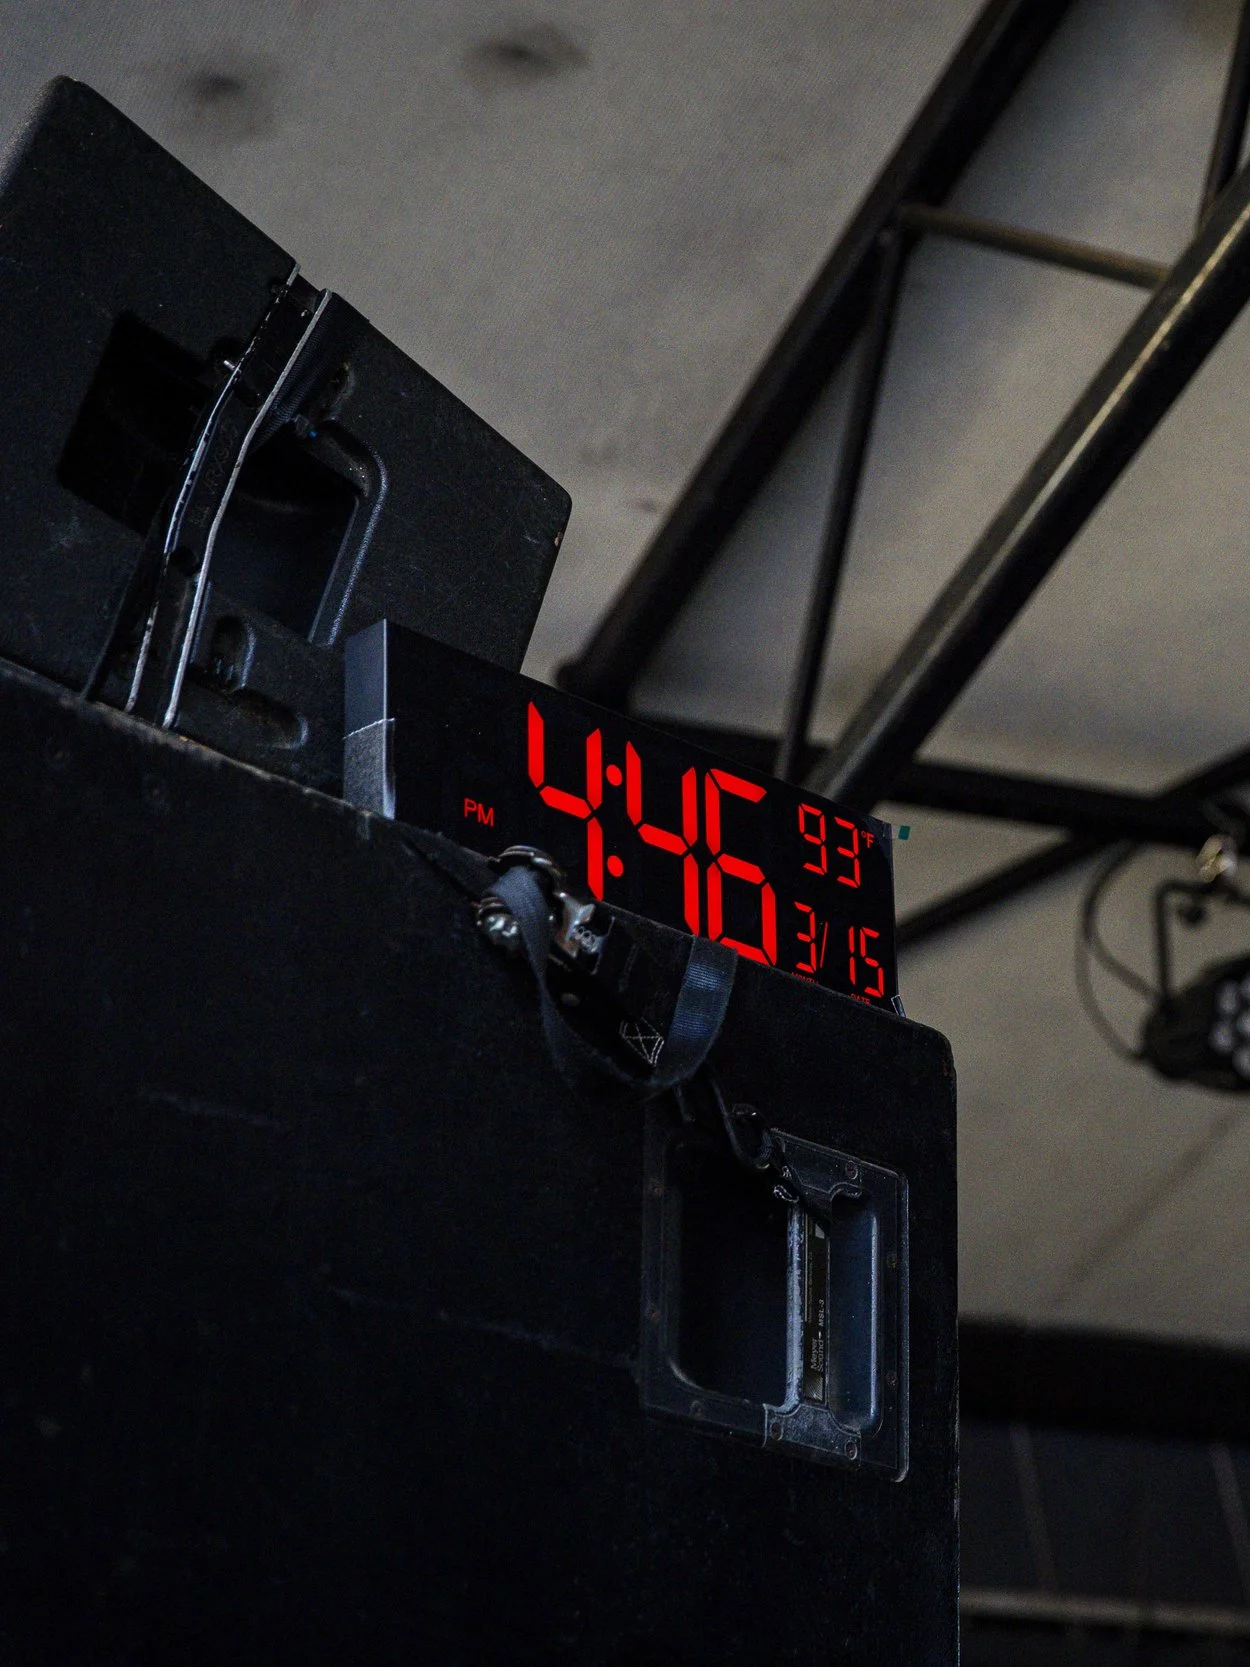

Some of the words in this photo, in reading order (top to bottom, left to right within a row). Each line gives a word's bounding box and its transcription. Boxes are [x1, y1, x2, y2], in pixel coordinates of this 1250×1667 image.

[463, 797, 495, 827] PM
[526, 700, 778, 967] 4:46
[793, 901, 885, 999] 3/15
[810, 1338, 819, 1370] Meyer
